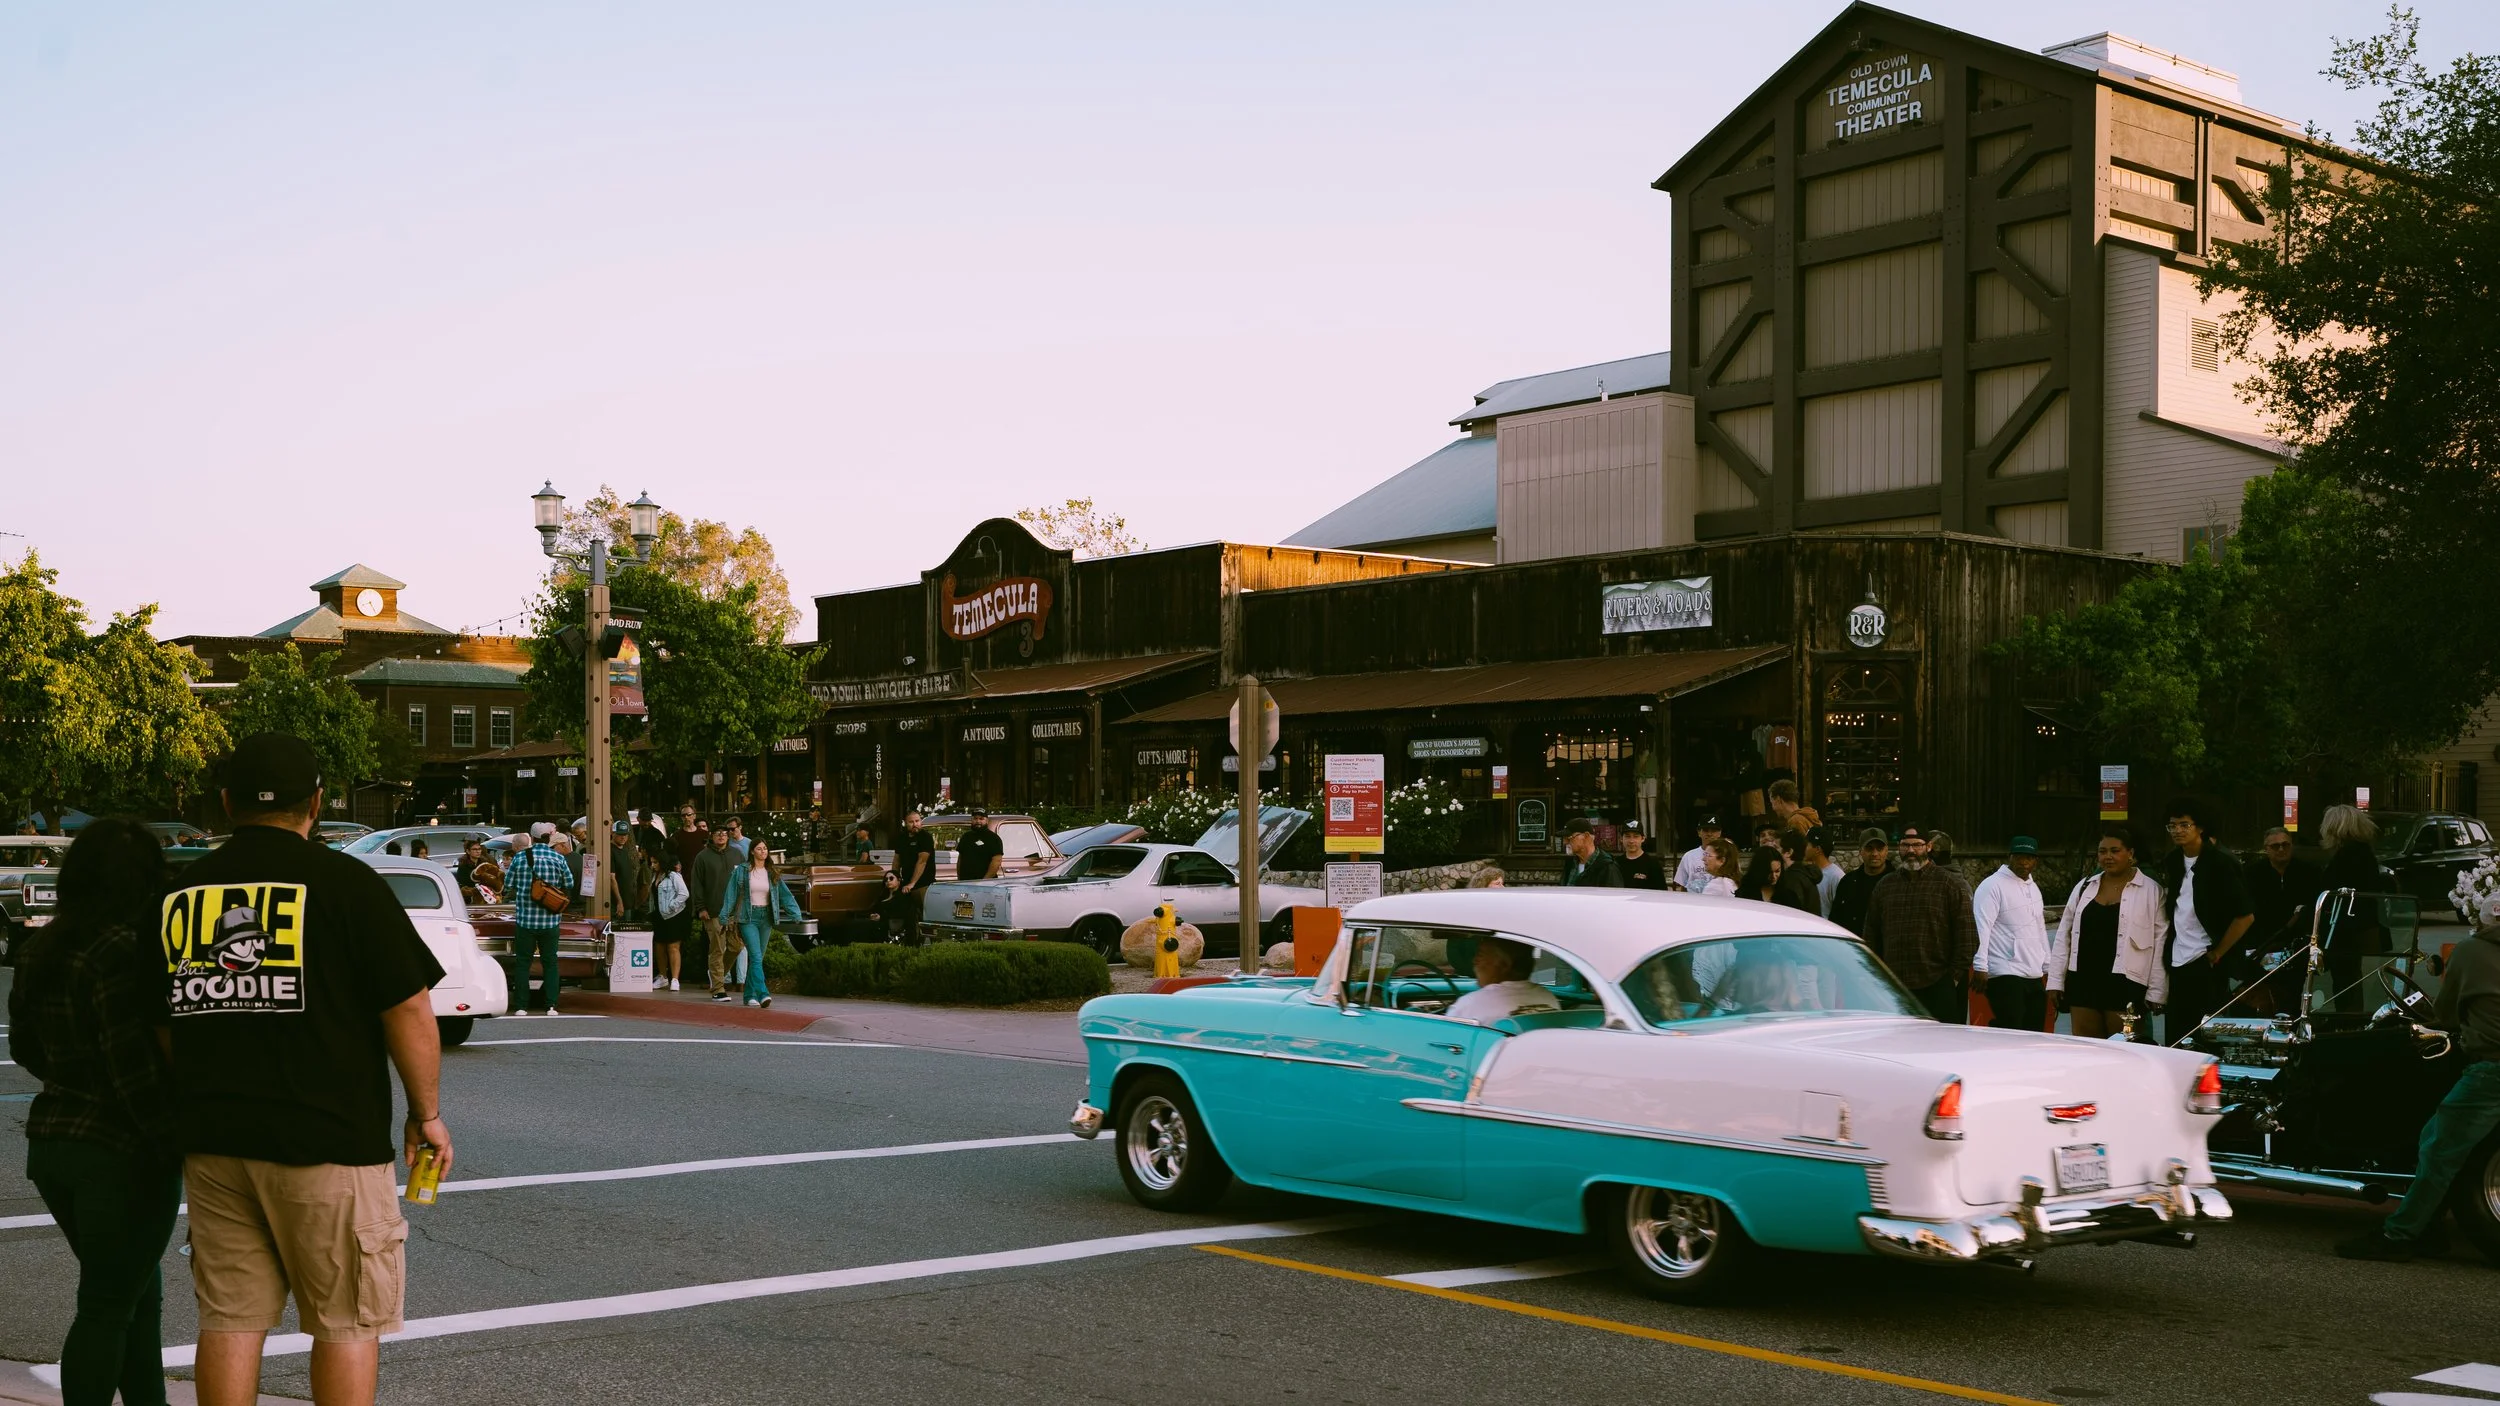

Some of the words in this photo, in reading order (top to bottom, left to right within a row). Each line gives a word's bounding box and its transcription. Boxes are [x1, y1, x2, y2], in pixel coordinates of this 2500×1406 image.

[1850, 64, 1872, 79] OLD
[1875, 53, 1909, 72] TOWN
[1826, 63, 1932, 107] TEMECULA
[1847, 89, 1911, 115] COMMUNITY
[1835, 101, 1922, 138] THEATER
[953, 582, 1038, 635] TEMECULA
[1605, 596, 1651, 619] RIVERS
[1652, 595, 1662, 615] &
[1666, 590, 1711, 614] ROADS
[608, 618, 624, 628] ROD
[625, 620, 643, 629] RUN
[1850, 614, 1886, 636] R&R
[811, 685, 830, 701] OLD
[831, 684, 862, 701] TOWN
[864, 680, 912, 700] ANTIQUE
[915, 674, 950, 695] FAIRE
[609, 697, 624, 706] Old
[625, 697, 645, 707] Town
[899, 719, 928, 731] OP
[963, 726, 1005, 741] ANTIQUES
[1032, 721, 1082, 738] COLLECTABLES
[773, 738, 809, 752] ANTIQUES
[1137, 750, 1161, 765] GIFTS
[1165, 749, 1188, 765] MORE
[175, 958, 209, 977] But
[171, 975, 298, 1003] GOODIE
[222, 1001, 278, 1009] ORIGINAL
